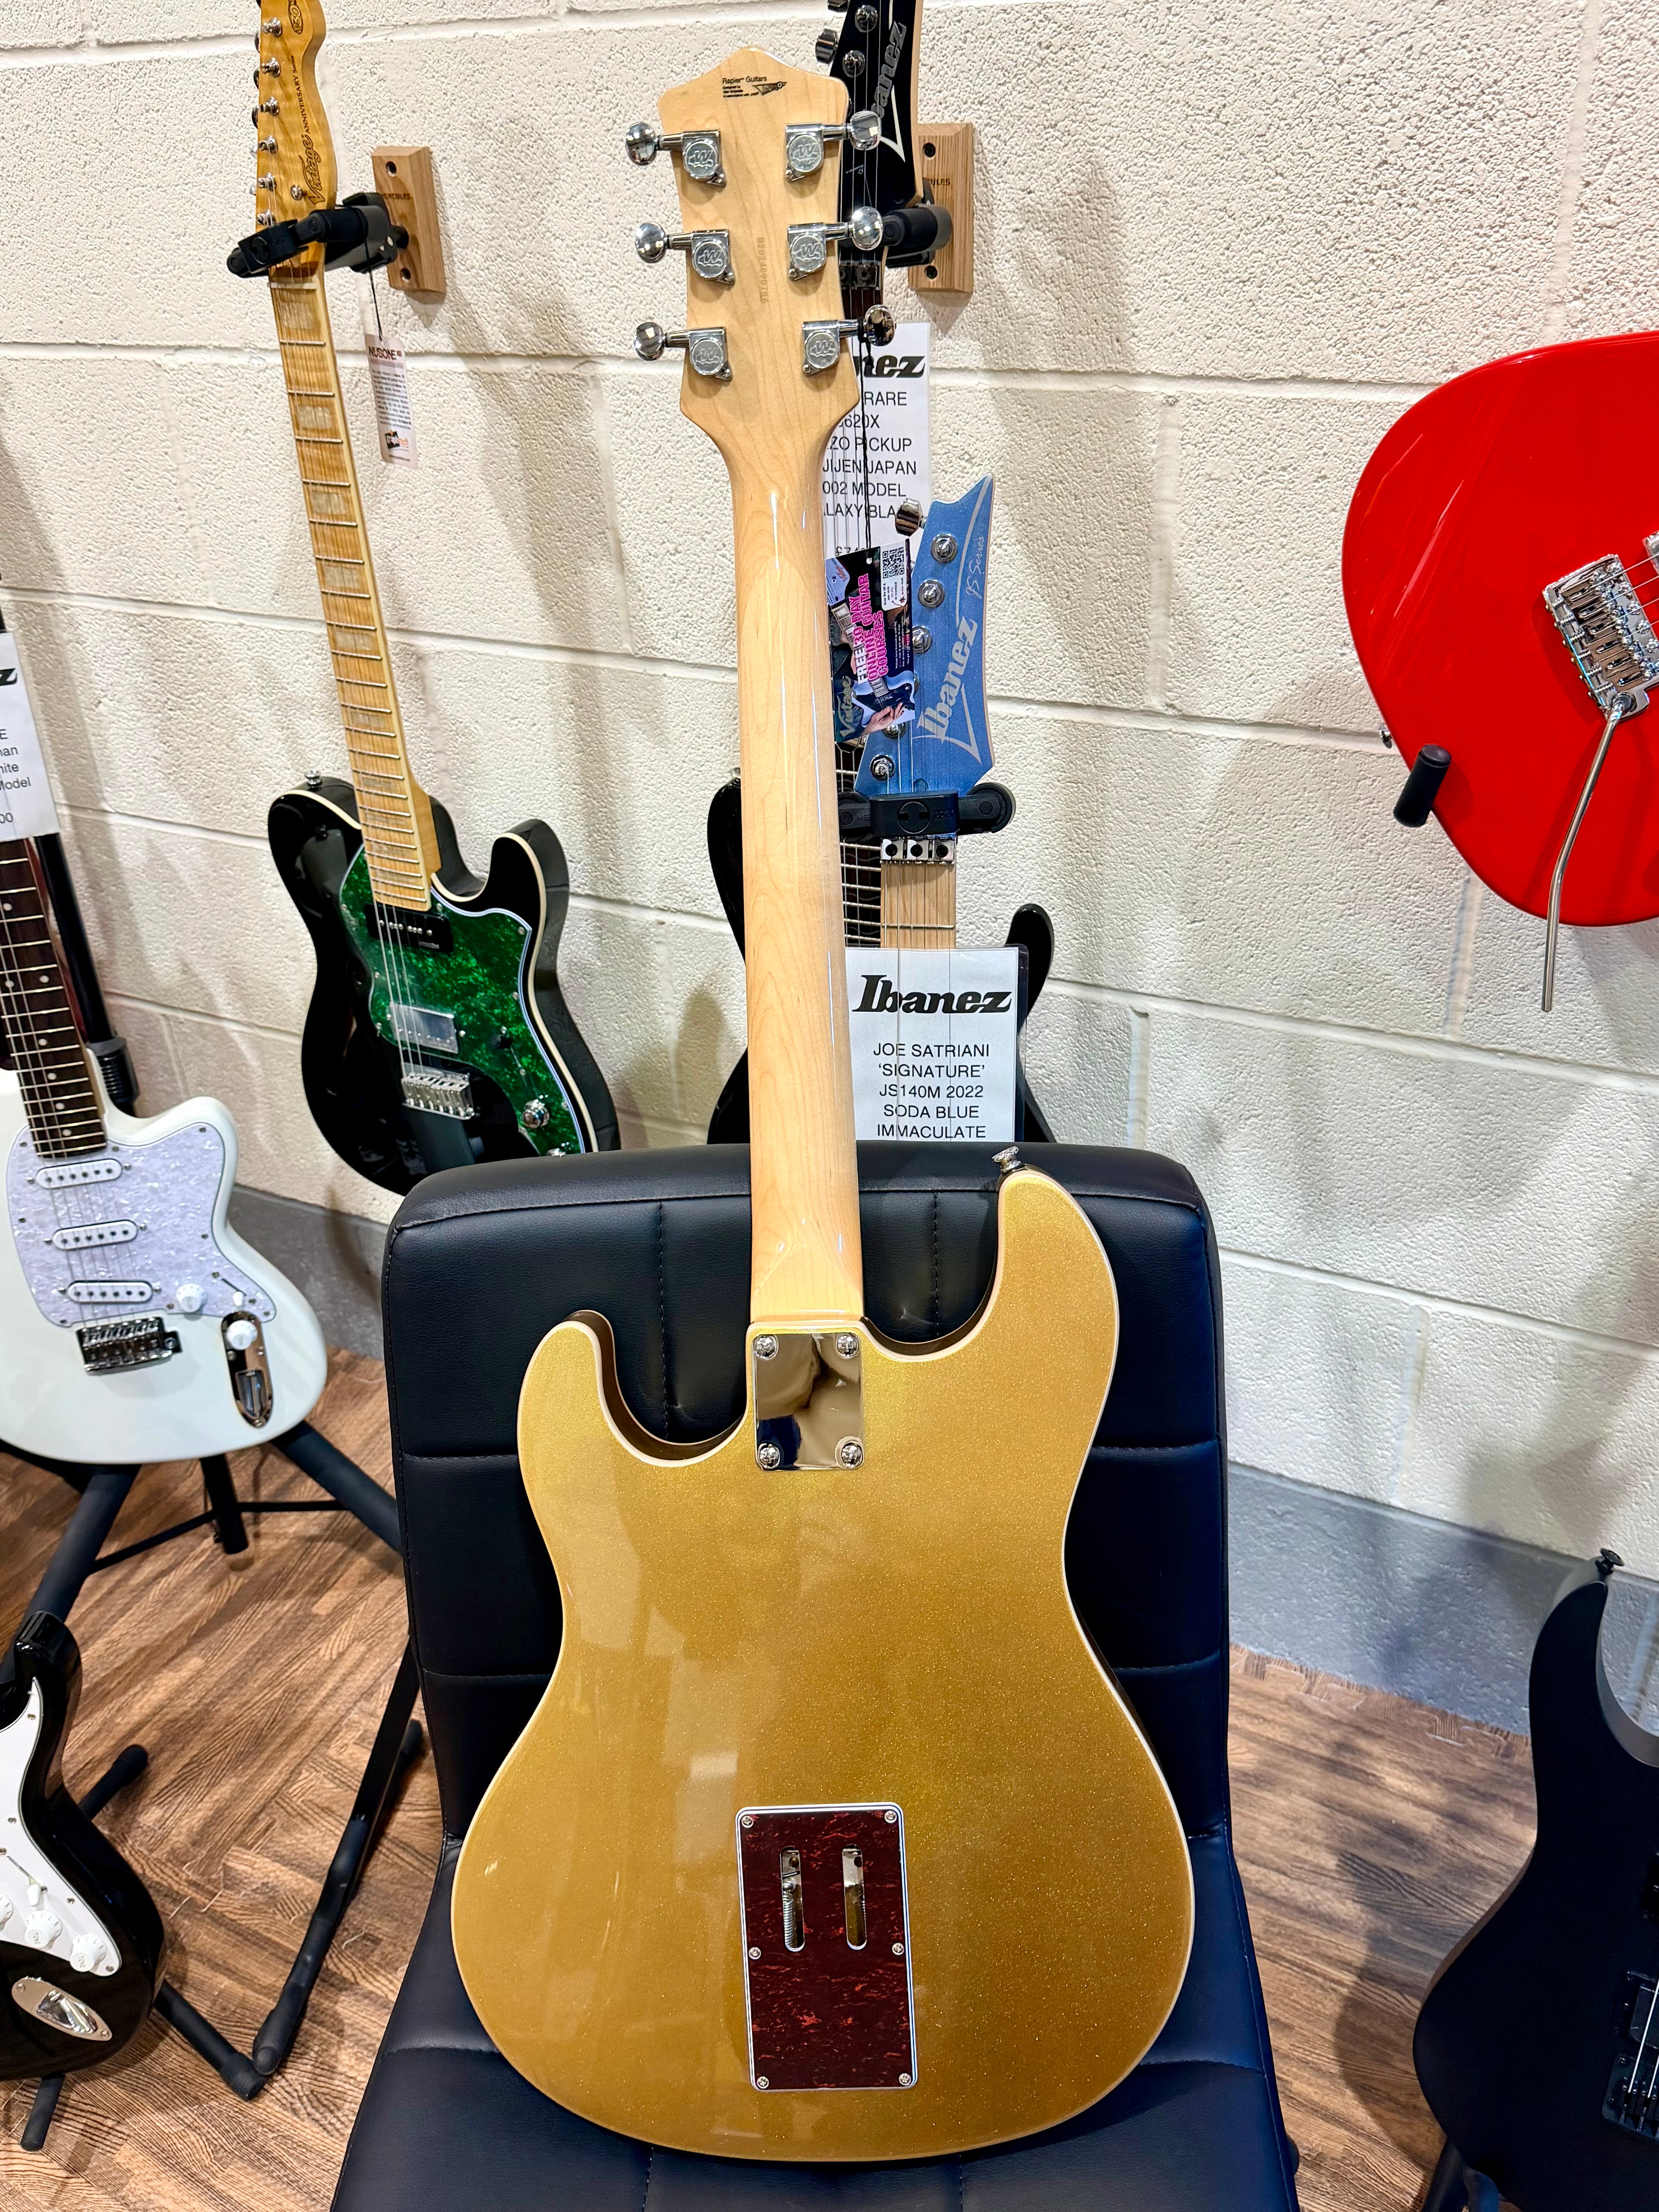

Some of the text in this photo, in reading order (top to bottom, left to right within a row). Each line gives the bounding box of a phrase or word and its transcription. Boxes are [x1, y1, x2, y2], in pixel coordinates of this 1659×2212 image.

[871, 21, 907, 118] anez
[293, 75, 311, 134] ANNIVERSARY
[299, 135, 326, 205] Vintage
[853, 355, 926, 378] nez
[864, 392, 907, 406] RARE
[838, 414, 880, 428] 620X
[827, 436, 912, 452] ZO PCKUP
[868, 460, 916, 475] JAPAN
[822, 481, 907, 497] 002 MODEL
[823, 503, 897, 519] LAXY BLA
[858, 573, 878, 682] ONLINE GUITAR
[848, 596, 868, 685] FREE 30 DAY
[872, 610, 888, 677] COURSES
[916, 615, 978, 744] Ibanez
[852, 975, 1012, 1014] Ibanez
[873, 1043, 989, 1058] JOE SATRIANI
[879, 1084, 983, 1098] JS140M 2022
[884, 1104, 979, 1118] SODA BLUE
[878, 1125, 986, 1138] IMMACULATE
